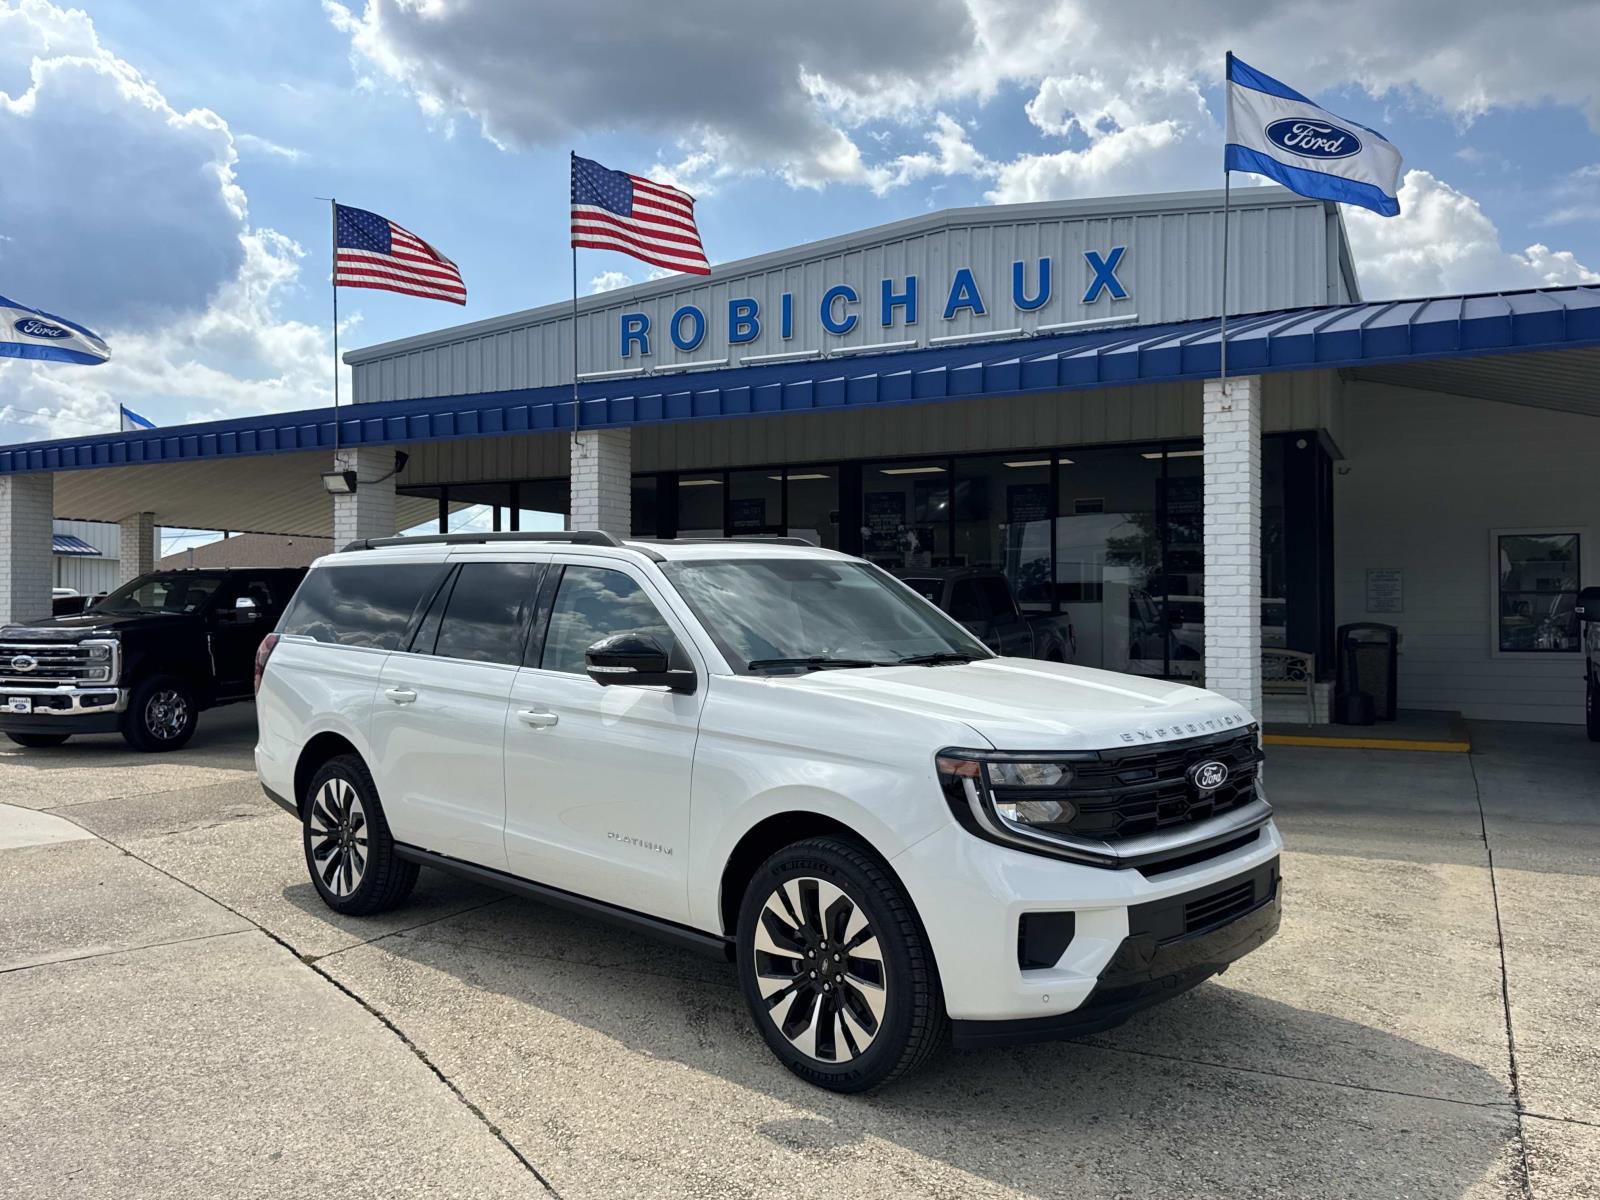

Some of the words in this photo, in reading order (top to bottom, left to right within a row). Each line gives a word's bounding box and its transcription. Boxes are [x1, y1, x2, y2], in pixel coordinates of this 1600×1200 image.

[1283, 123, 1345, 153] Ford
[620, 245, 1131, 359] ROBICHAUX
[23, 320, 63, 337] Ford
[1119, 712, 1243, 742] EXPEDITION
[1201, 765, 1223, 786] Ford
